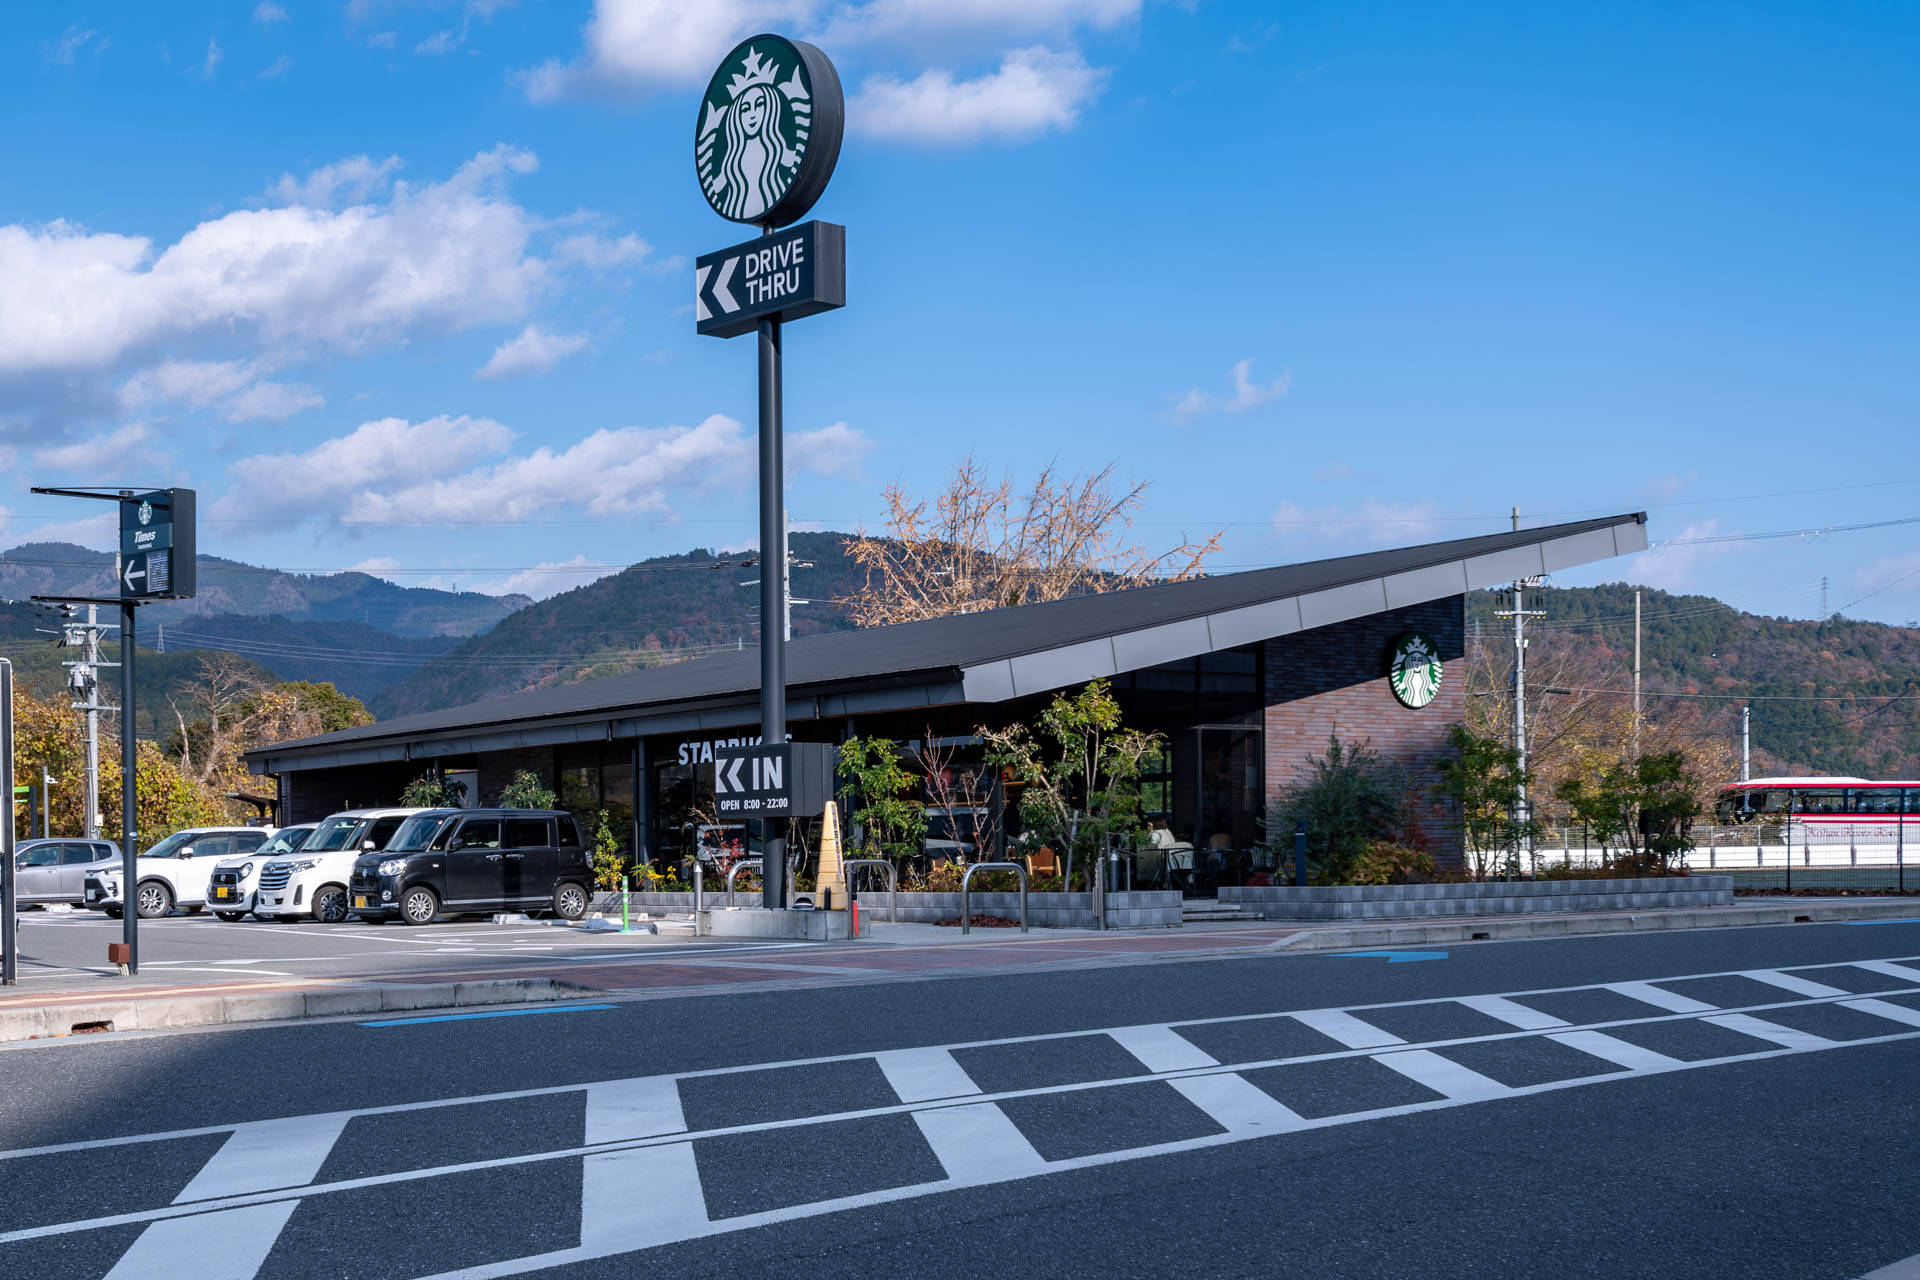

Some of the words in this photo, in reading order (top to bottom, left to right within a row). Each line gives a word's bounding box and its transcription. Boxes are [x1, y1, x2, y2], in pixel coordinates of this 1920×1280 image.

[745, 238, 804, 279] DRIVE
[745, 267, 799, 305] THRU
[134, 531, 156, 543] Times
[752, 756, 783, 790] IN
[721, 800, 740, 810] OPEN
[743, 800, 760, 810] 8:00
[766, 798, 788, 808] 22:00
